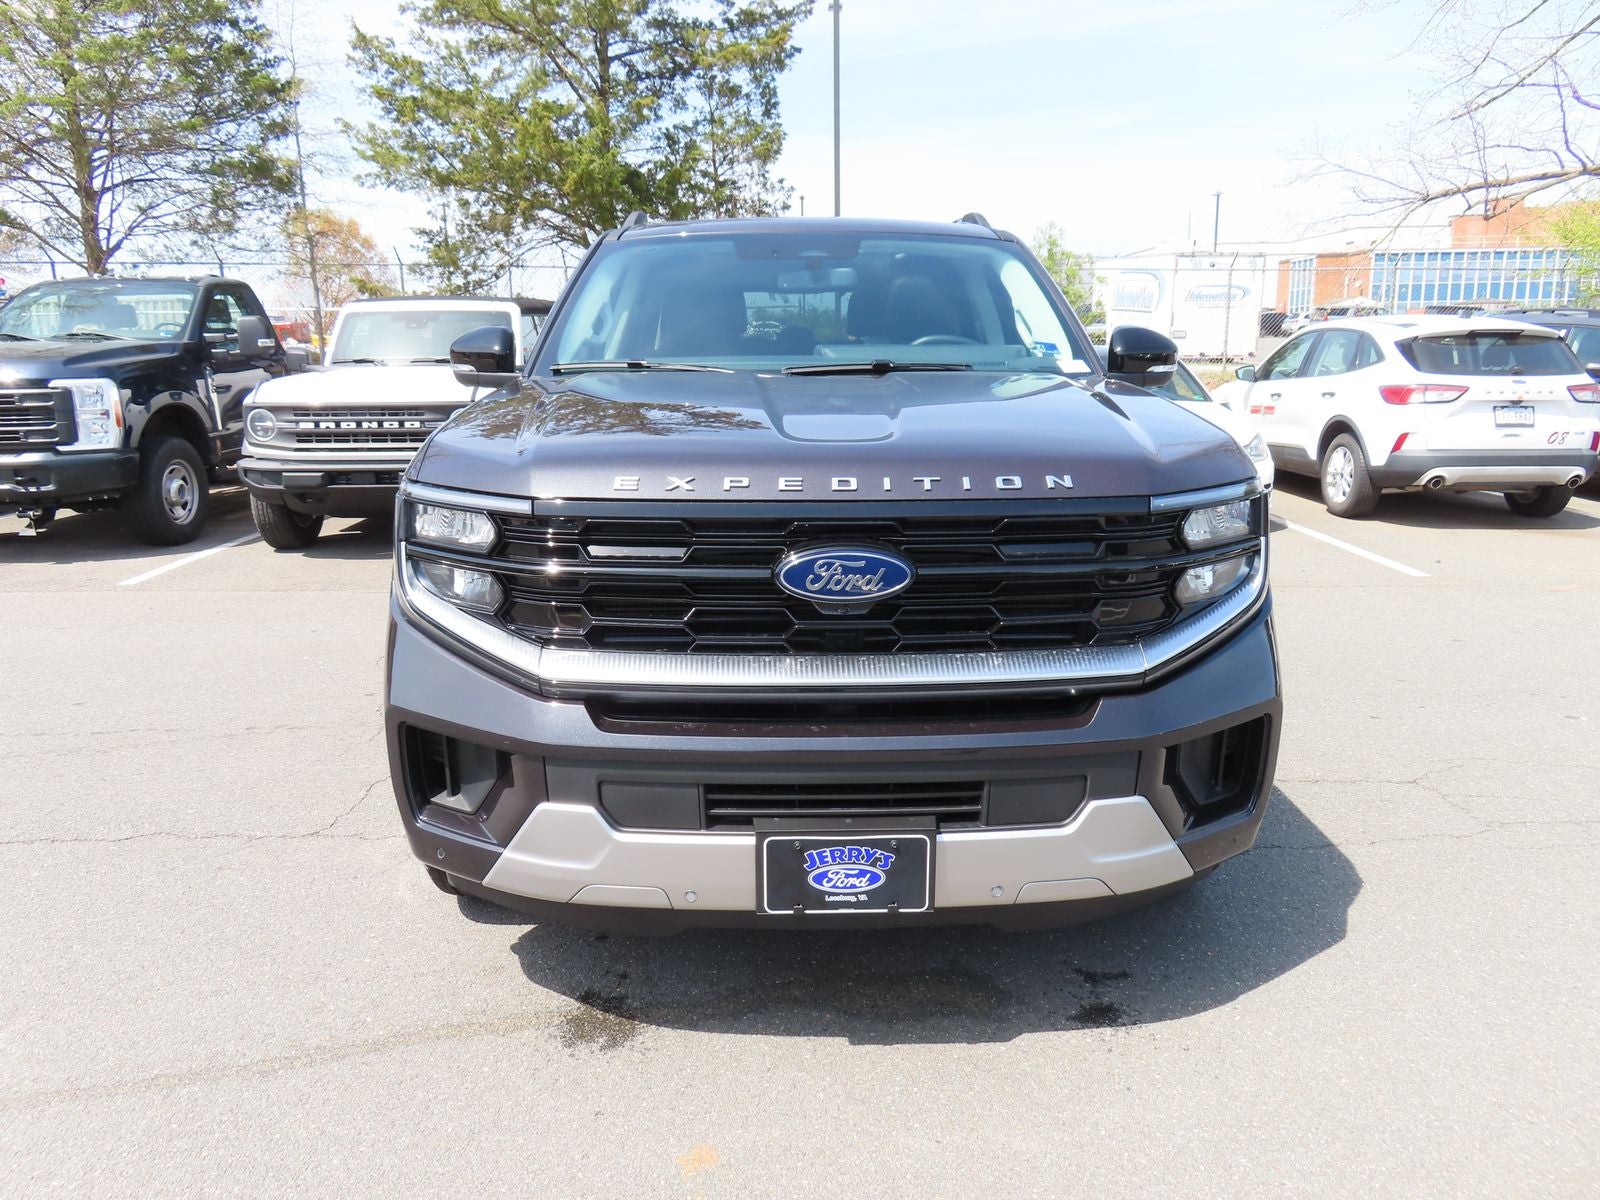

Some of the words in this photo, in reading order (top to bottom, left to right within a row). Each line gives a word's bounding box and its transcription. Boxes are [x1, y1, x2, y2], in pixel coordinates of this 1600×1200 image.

[299, 421, 421, 429] BRONCO
[613, 475, 1074, 491] EXPEDITION
[805, 558, 884, 592] Ford
[804, 846, 895, 870] JERRY'S
[823, 870, 870, 888] Ford
